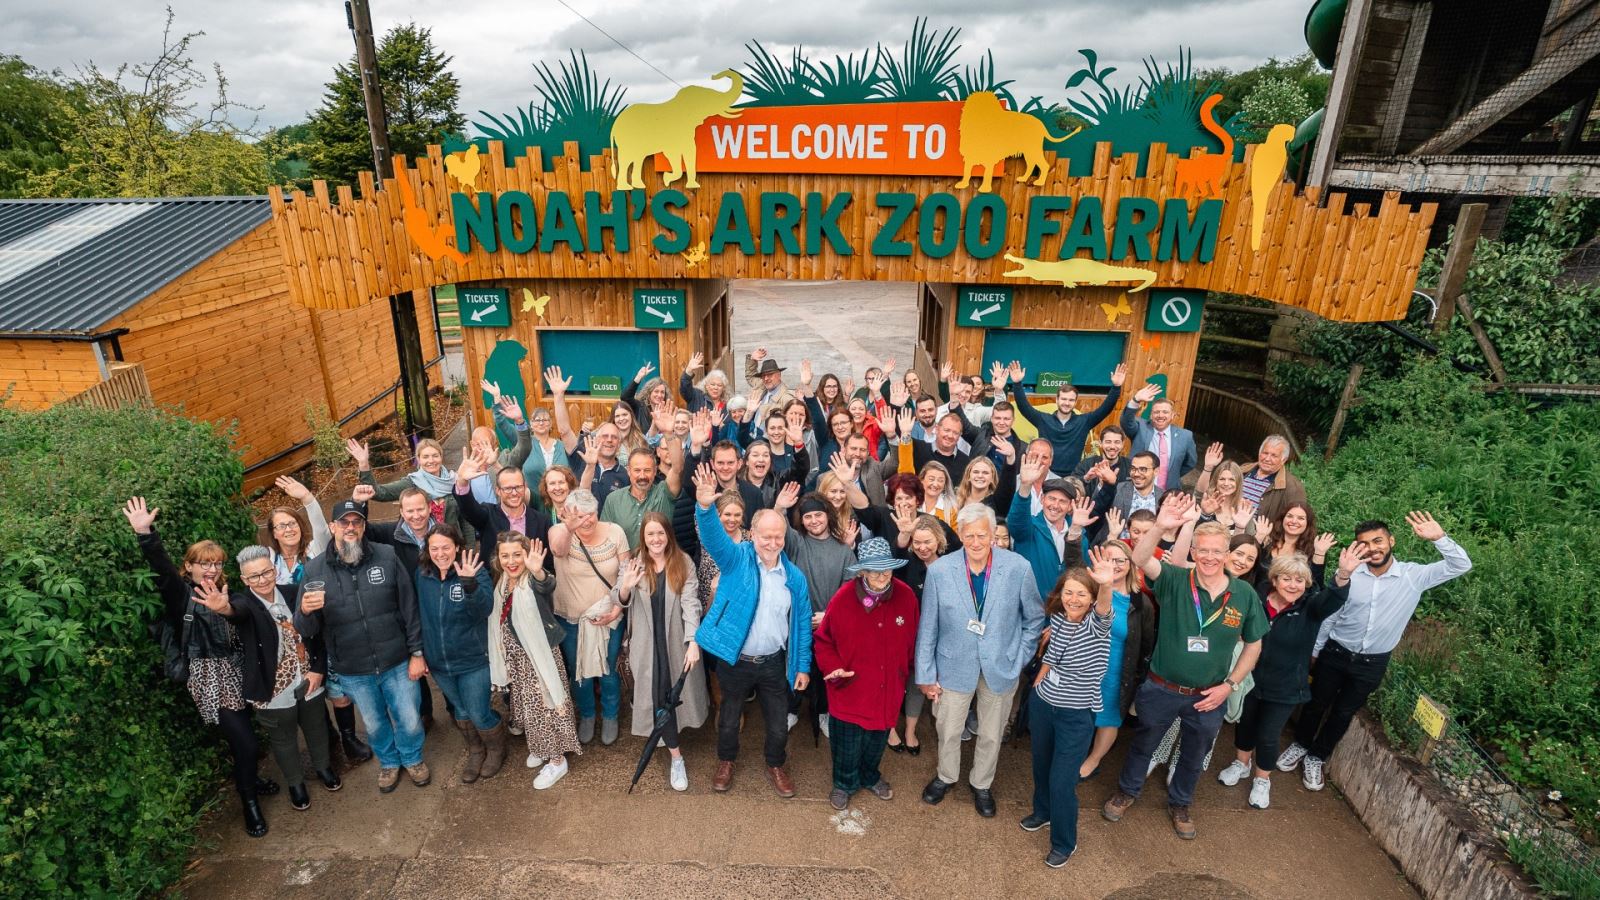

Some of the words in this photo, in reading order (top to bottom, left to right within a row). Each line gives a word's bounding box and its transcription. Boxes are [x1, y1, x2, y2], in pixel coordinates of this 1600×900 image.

[711, 123, 888, 160] WELCOME
[903, 123, 947, 160] TO
[451, 190, 692, 254] NOAH'S
[710, 191, 853, 256] ARK
[872, 192, 1008, 259] ZOO
[1024, 195, 1224, 263] FARM
